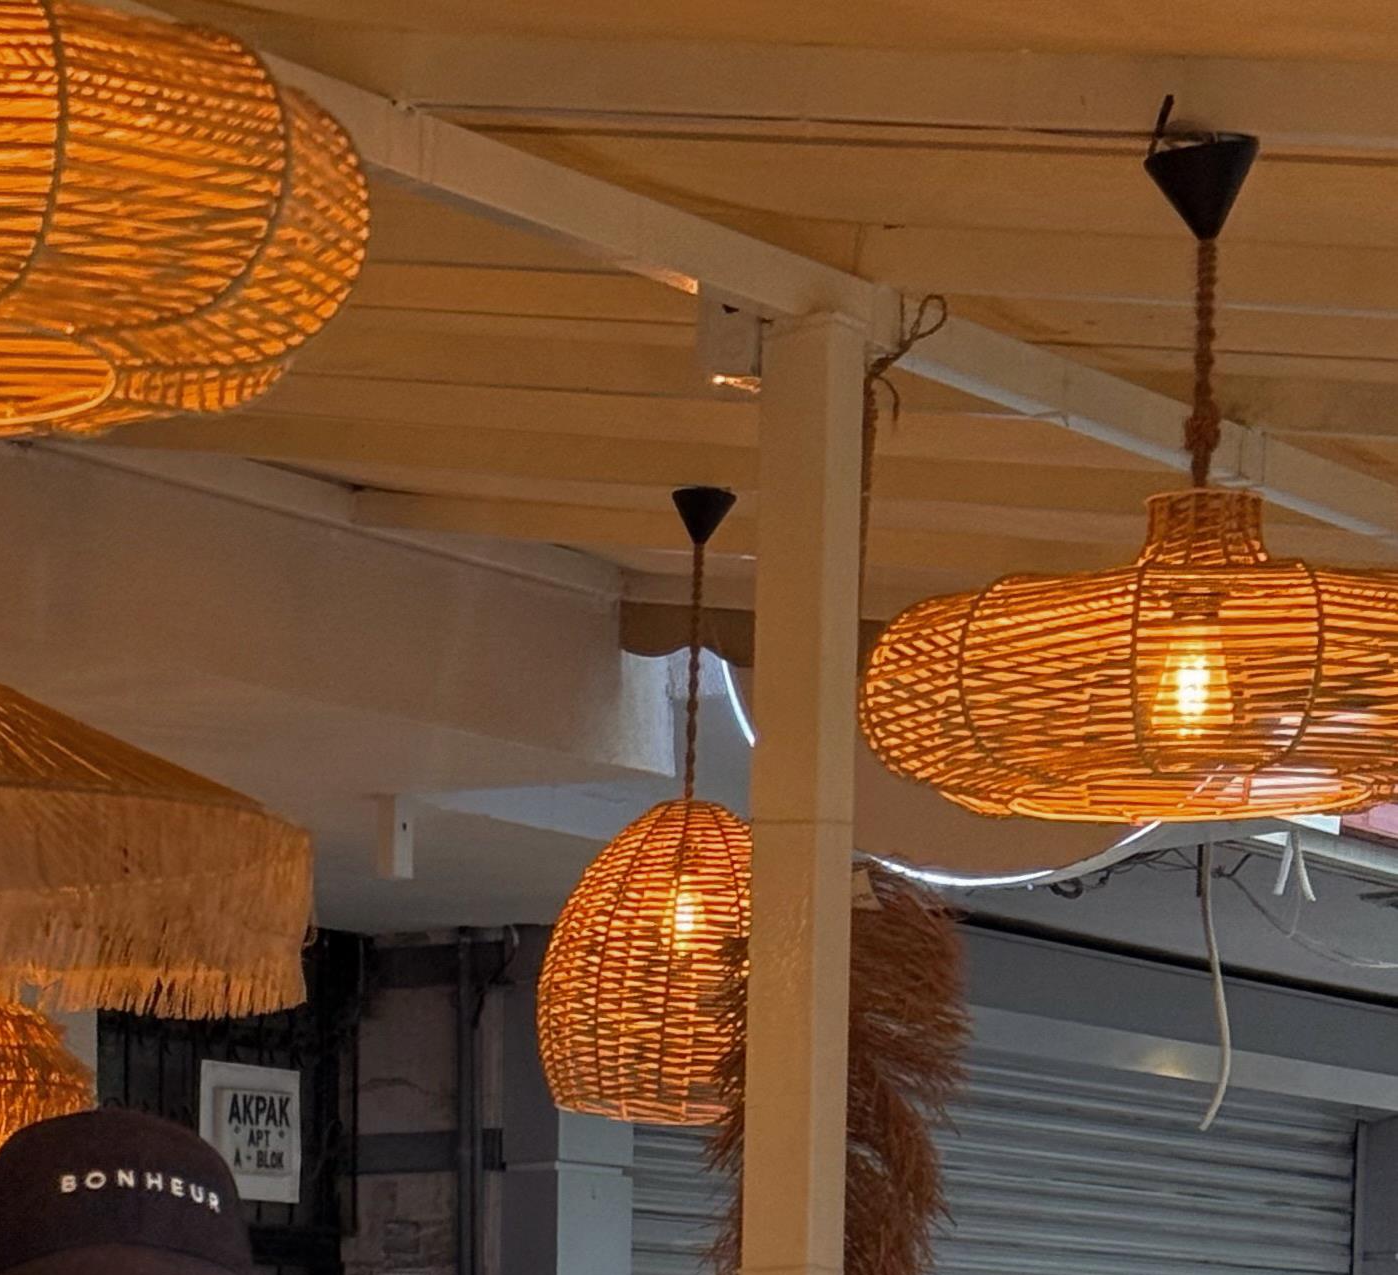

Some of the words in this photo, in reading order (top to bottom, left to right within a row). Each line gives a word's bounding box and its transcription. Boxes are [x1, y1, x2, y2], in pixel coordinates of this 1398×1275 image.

[228, 1092, 291, 1128] AKPAK
[247, 1129, 271, 1148] APT
[60, 1168, 221, 1213] BONHEUR
